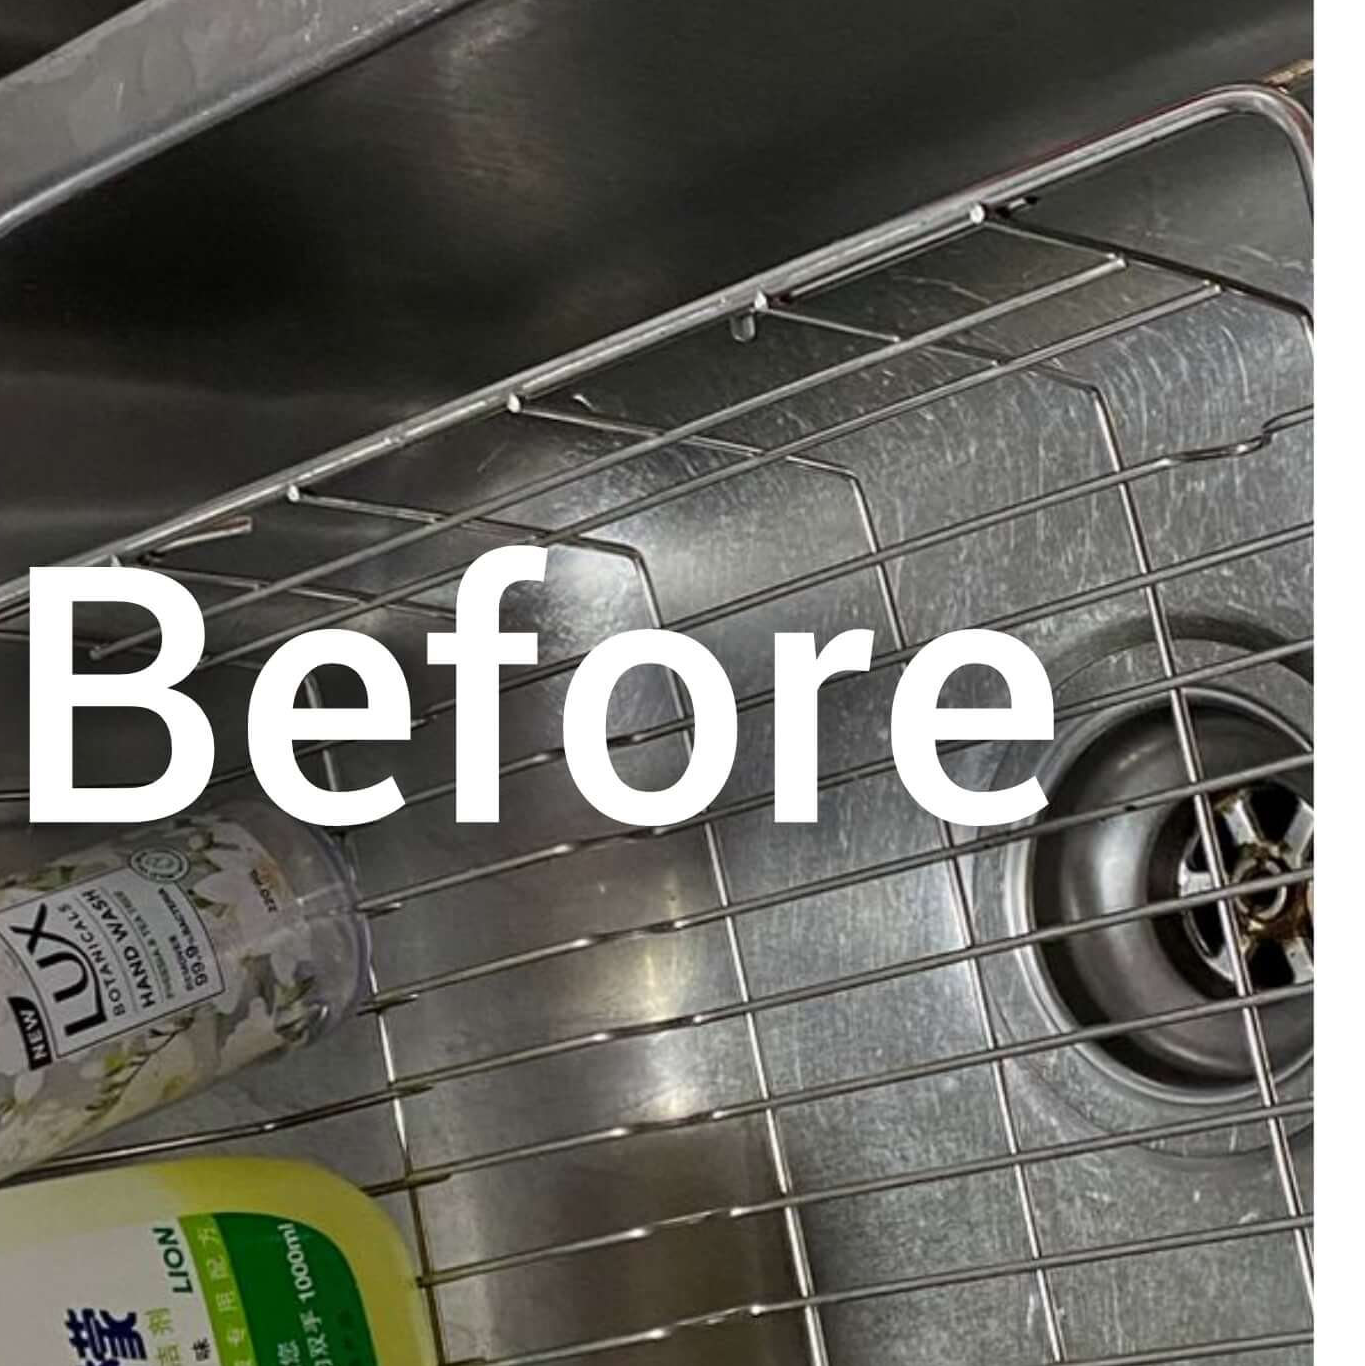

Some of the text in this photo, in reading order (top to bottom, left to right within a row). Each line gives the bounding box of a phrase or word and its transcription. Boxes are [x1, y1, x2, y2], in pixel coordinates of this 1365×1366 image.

[10, 903, 107, 1036] LUX
[57, 903, 126, 1017] BOTANICALS
[82, 888, 156, 1010] HAND WASH
[20, 1009, 49, 1061] NEW
[153, 1227, 194, 1294] LION
[277, 1223, 316, 1302] 1000ml
